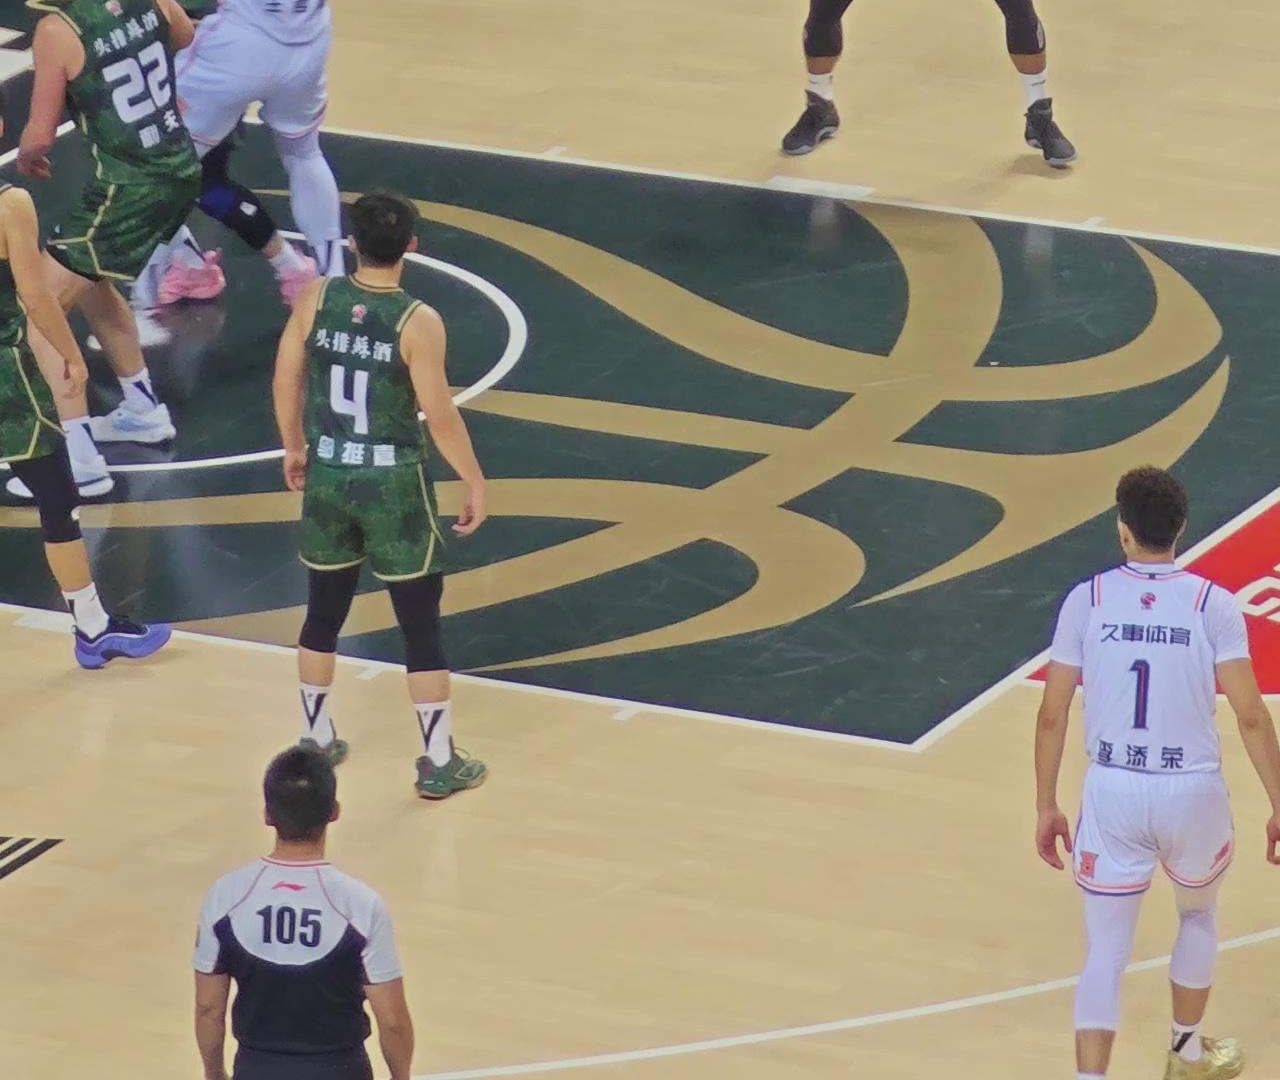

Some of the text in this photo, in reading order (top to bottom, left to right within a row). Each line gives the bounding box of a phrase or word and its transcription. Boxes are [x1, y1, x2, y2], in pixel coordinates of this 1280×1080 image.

[102, 40, 172, 124] 22
[330, 363, 369, 435] 4
[1100, 623, 1191, 647] 久事体育
[1129, 659, 1150, 729] 1
[256, 905, 322, 948] 105
